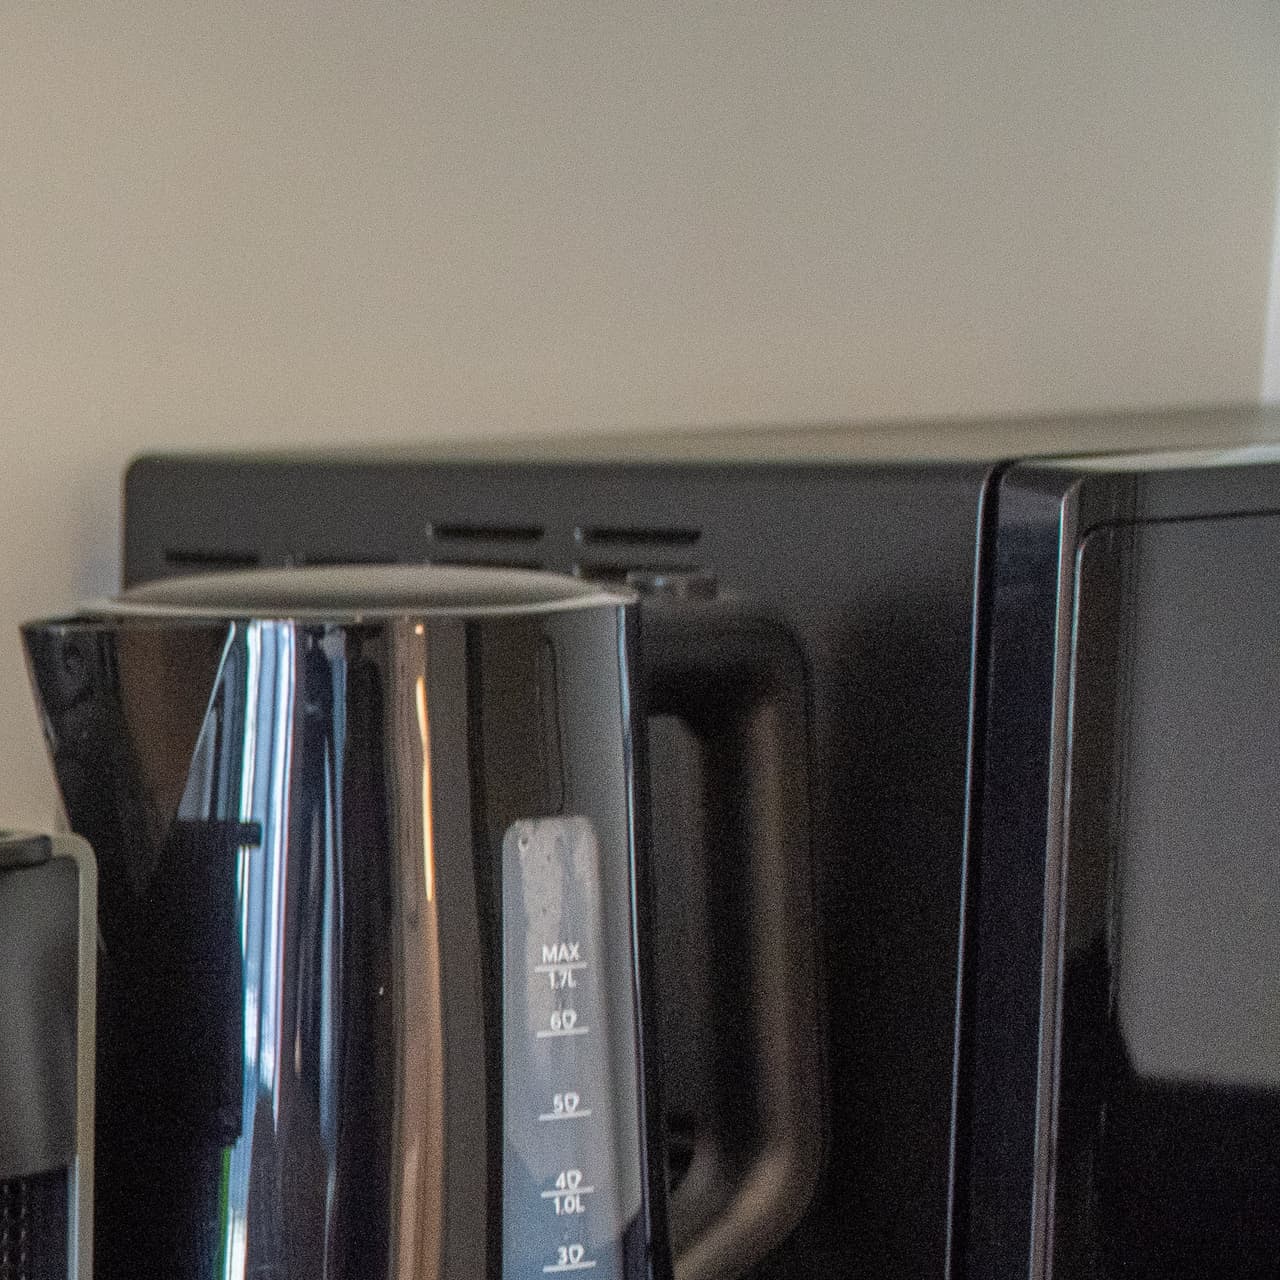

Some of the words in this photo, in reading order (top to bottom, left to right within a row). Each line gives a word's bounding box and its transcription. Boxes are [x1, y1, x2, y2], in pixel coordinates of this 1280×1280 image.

[542, 944, 580, 963] MAX
[548, 969, 577, 990] 1.7L
[553, 1197, 586, 1215] 1.0L
